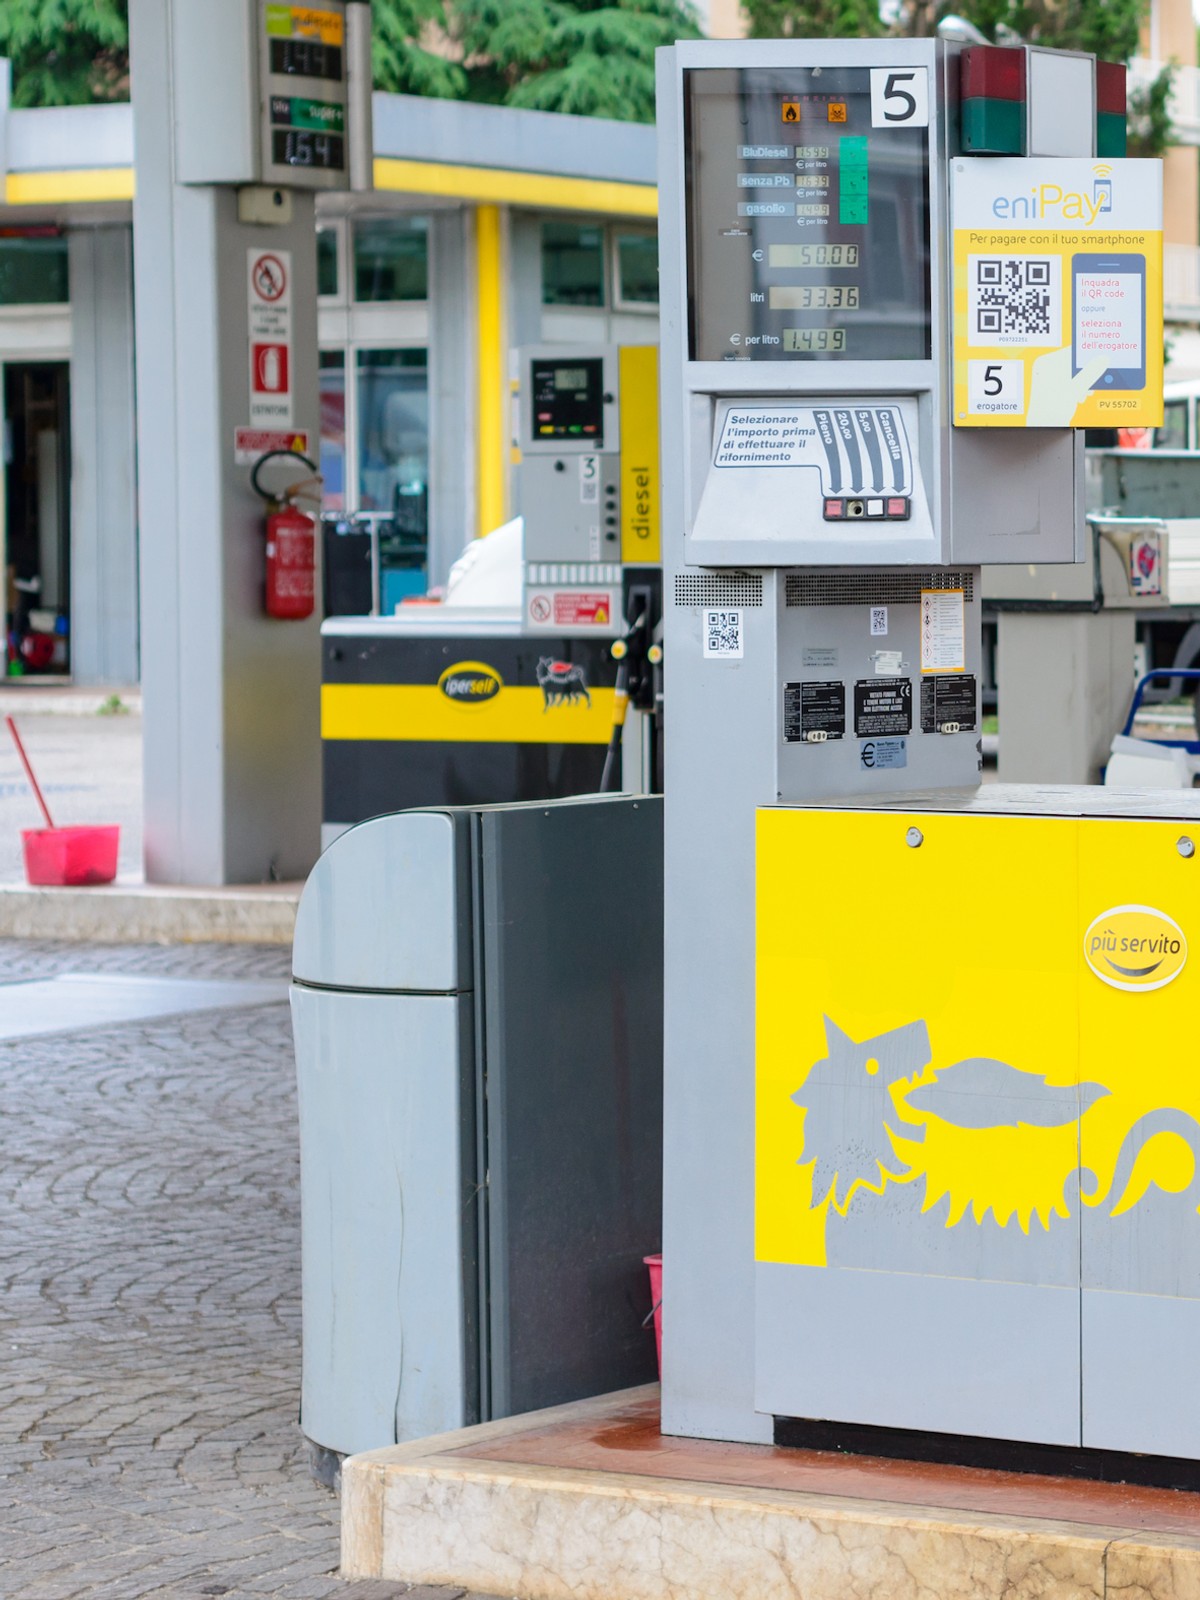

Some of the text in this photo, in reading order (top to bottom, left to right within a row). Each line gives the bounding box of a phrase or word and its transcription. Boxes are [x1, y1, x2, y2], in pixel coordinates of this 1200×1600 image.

[884, 73, 917, 121] 5
[742, 147, 788, 157] BluDiesel
[742, 176, 790, 186] senza Pb
[746, 203, 785, 216] gasolio
[992, 183, 1106, 226] eniPay
[969, 233, 1145, 246] Per pagare con il tuo smartphone
[752, 249, 764, 262] €
[801, 246, 857, 265] 50.00
[1081, 278, 1120, 288] Inquadra
[750, 292, 765, 302] litri
[802, 288, 857, 308] 33.36
[1081, 289, 1125, 299] il QR code
[1081, 305, 1106, 313] oppure
[1081, 319, 1122, 328] seleziona
[729, 333, 780, 346] € per litro
[792, 330, 844, 350] 1.499
[1081, 330, 1121, 339] il numero
[1081, 341, 1138, 352] dell'erogatore
[984, 365, 1003, 396] 5
[976, 402, 1018, 412] erogatore
[1112, 400, 1138, 409] 55702
[731, 415, 799, 424] Selezionare
[837, 412, 852, 440] 20,00
[859, 412, 871, 433] 5,00
[727, 427, 816, 438] l'importo prima
[817, 413, 833, 444] Pieno
[880, 411, 901, 460] Cancella
[723, 439, 806, 449] di effettuare il
[719, 452, 791, 462] rifornimento
[583, 457, 596, 478] 3
[631, 467, 649, 539] diesel
[446, 675, 495, 696] iperself
[861, 742, 876, 768] €
[1090, 929, 1181, 956] più servito
